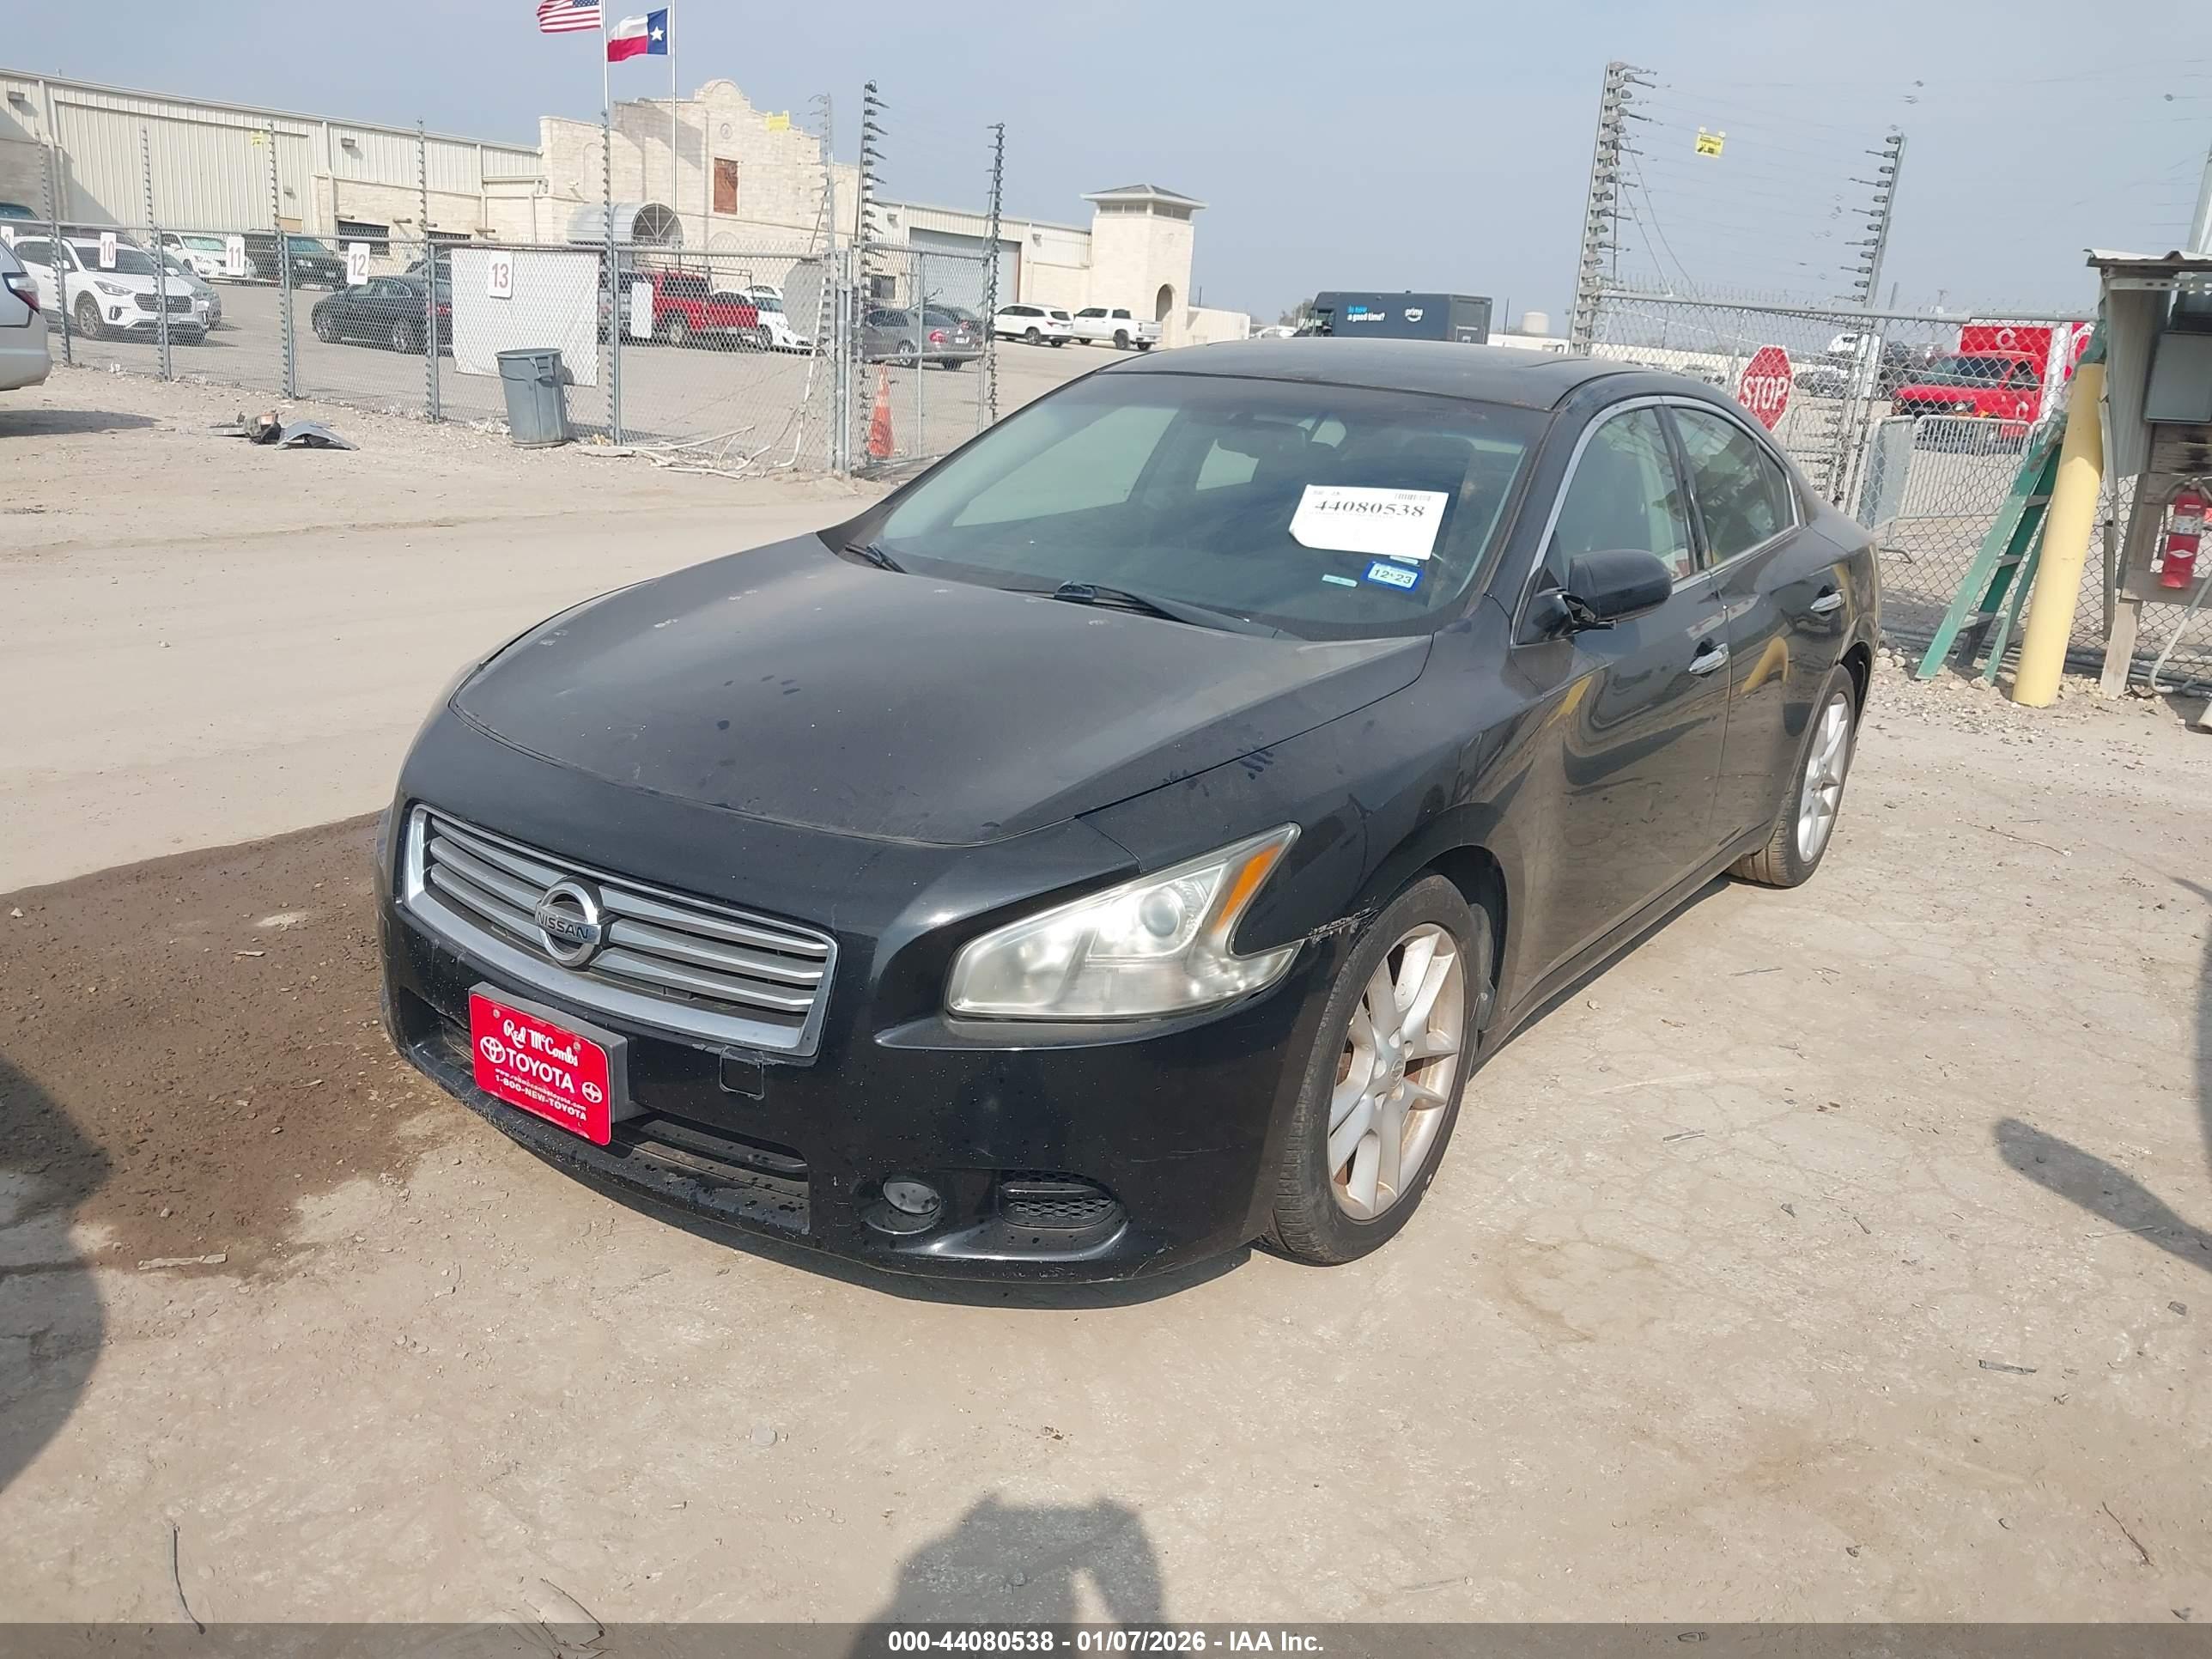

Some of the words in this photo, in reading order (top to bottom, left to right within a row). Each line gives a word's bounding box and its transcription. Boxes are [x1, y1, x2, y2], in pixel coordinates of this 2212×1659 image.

[101, 240, 115, 262] 10
[229, 246, 242, 269] 11
[351, 253, 366, 276] 12
[492, 263, 509, 289] 13
[1405, 307, 1424, 317] prime
[1741, 375, 1789, 410] STOP
[1315, 500, 1425, 517] 44080538
[538, 911, 589, 939] NISSAN
[503, 1019, 526, 1049] Red
[527, 1029, 579, 1066] McCombs
[506, 1047, 575, 1094] TOYOTA
[495, 1075, 587, 1121] 1-800-NEW-TOYOTA
